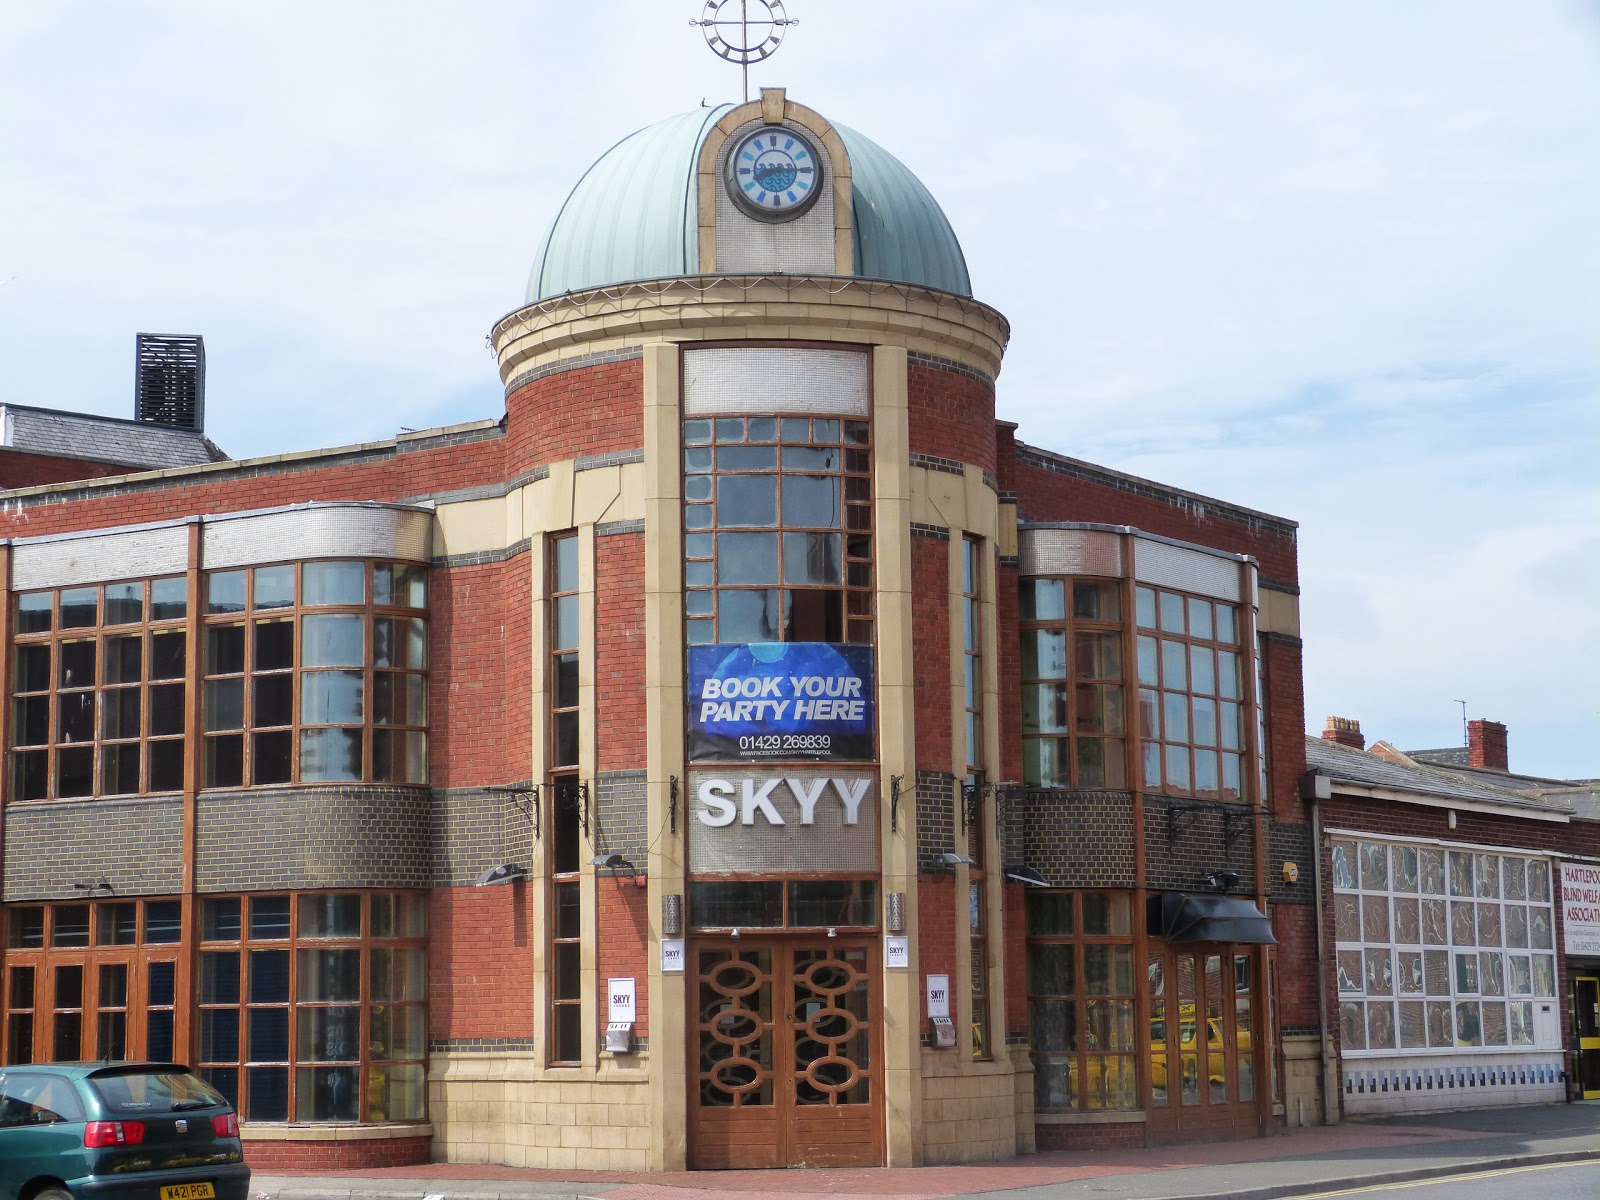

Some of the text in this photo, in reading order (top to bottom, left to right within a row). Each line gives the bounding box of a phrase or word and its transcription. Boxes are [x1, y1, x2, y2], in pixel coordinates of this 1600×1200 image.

[701, 676, 862, 699] BOOK YOUR
[700, 700, 866, 722] PARTY HERE
[739, 734, 831, 750] 01429 269839
[697, 778, 871, 827] SKYY
[1563, 887, 1582, 902] BLIND
[613, 994, 631, 1004] SKYY
[930, 990, 945, 999] SKYY
[166, 1184, 209, 1199] W421 PGR
